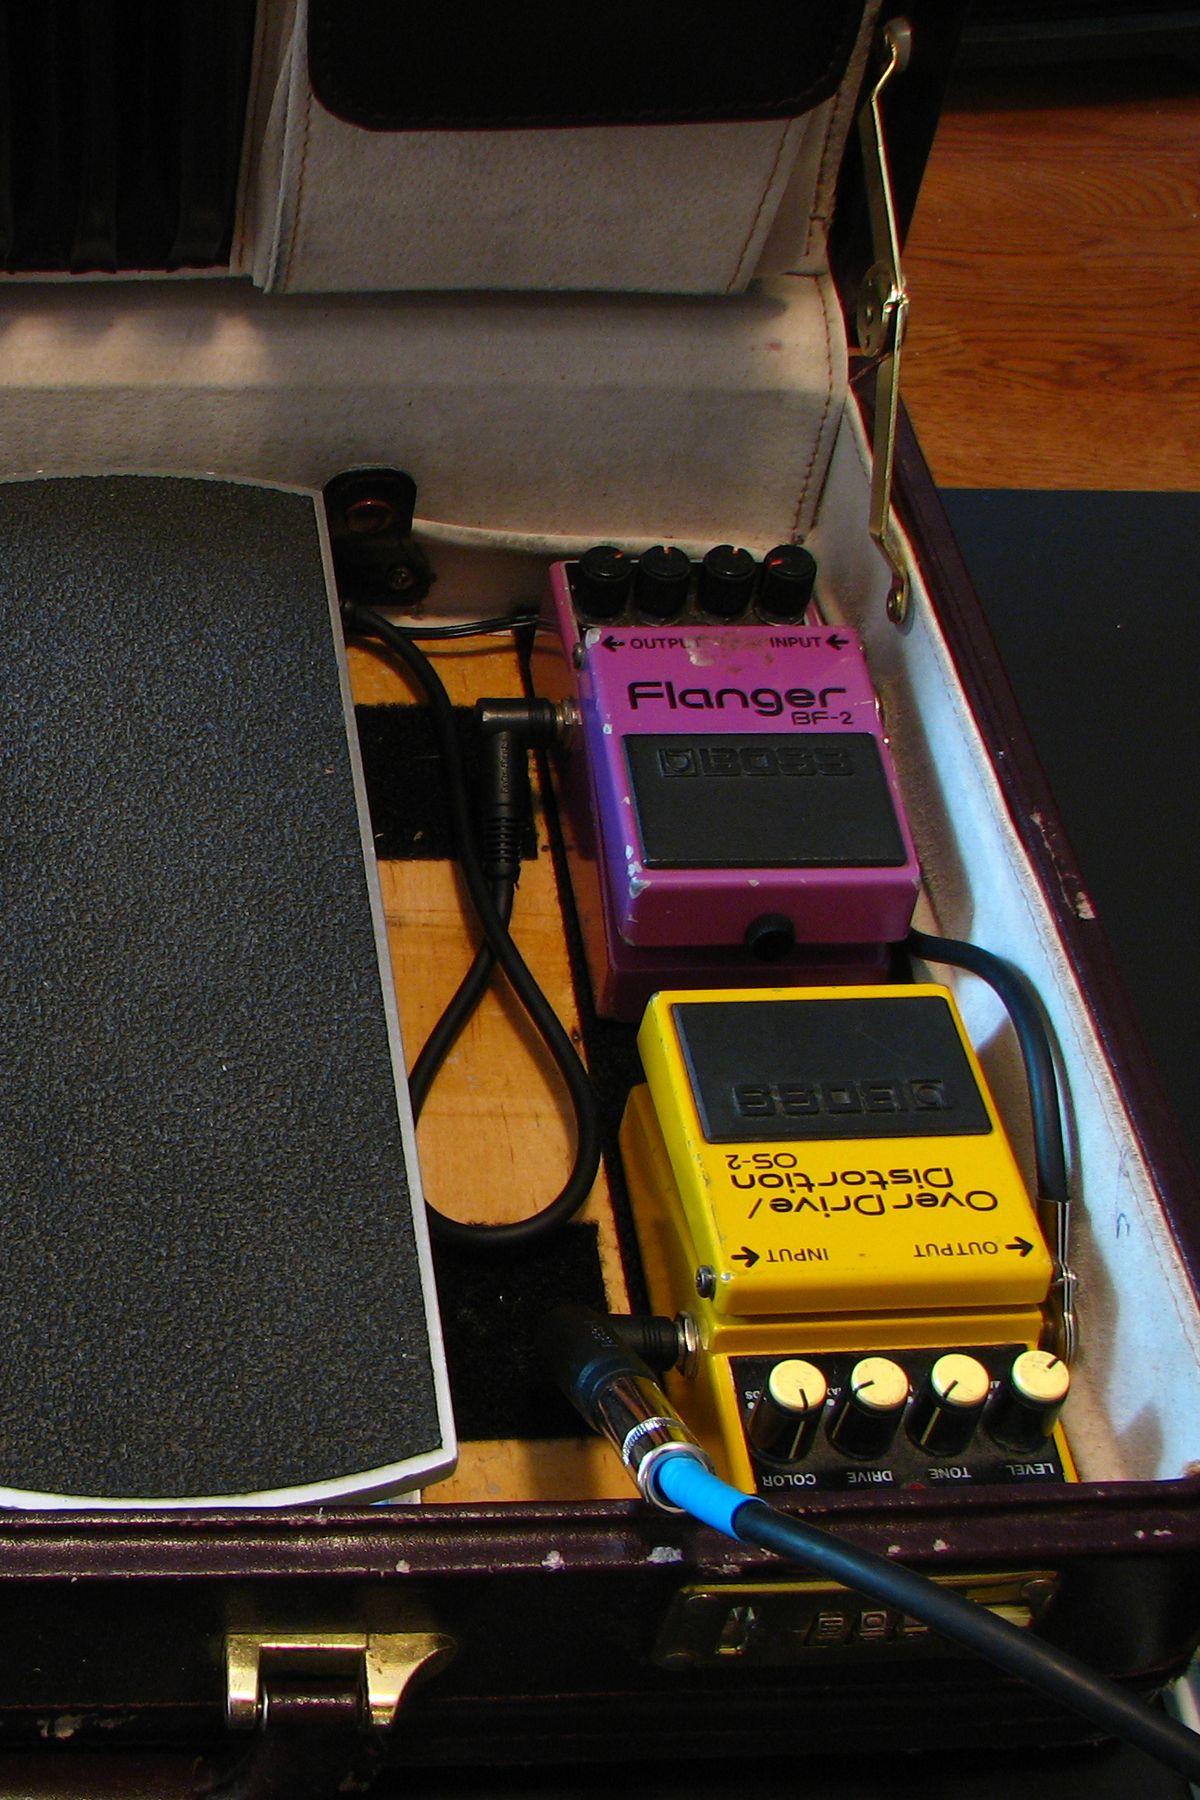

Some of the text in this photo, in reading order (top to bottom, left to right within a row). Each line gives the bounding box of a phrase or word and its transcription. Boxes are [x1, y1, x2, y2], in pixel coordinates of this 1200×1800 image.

[769, 637, 822, 649] INPUT
[627, 681, 847, 717] Flanger
[791, 712, 853, 725] BF-2
[726, 1152, 798, 1168] OS-2
[731, 1167, 954, 1193] Distortion
[766, 1247, 828, 1262] INPUT
[914, 1241, 999, 1257] OUTPUT
[848, 1470, 894, 1483] DRIVE
[929, 1466, 972, 1480] TONE
[1005, 1462, 1056, 1477] LEVEL
[762, 1472, 817, 1487] COLOR
